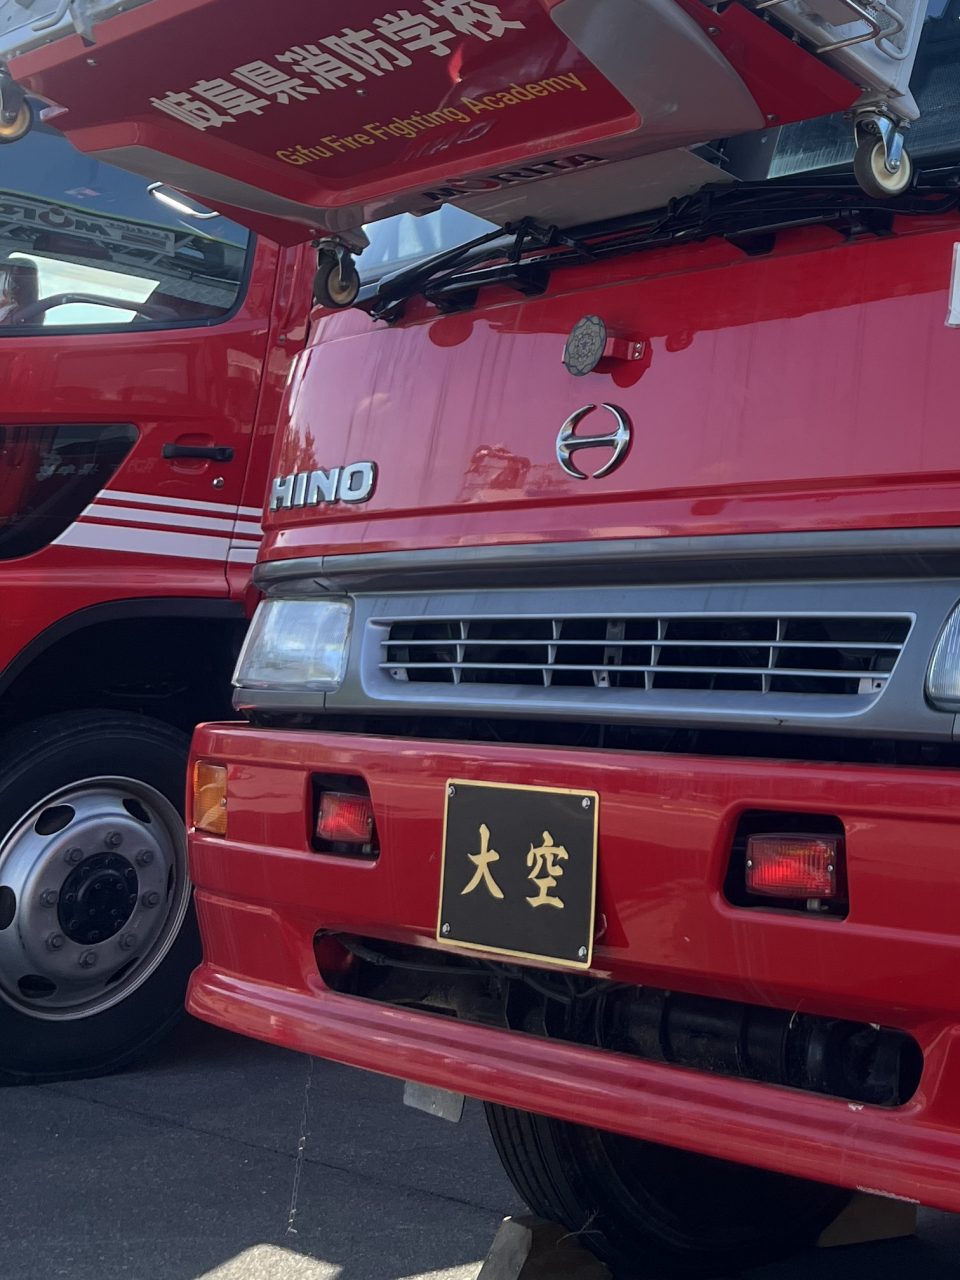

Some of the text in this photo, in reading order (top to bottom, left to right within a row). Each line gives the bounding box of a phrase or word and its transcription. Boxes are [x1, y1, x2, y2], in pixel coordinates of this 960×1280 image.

[276, 144, 334, 166] Gifu
[320, 134, 374, 154] Fire
[362, 106, 472, 141] Fighting
[460, 72, 588, 115] Academy
[422, 153, 609, 202] MORITA
[269, 461, 379, 512] HINO
[461, 823, 570, 909] 大空
